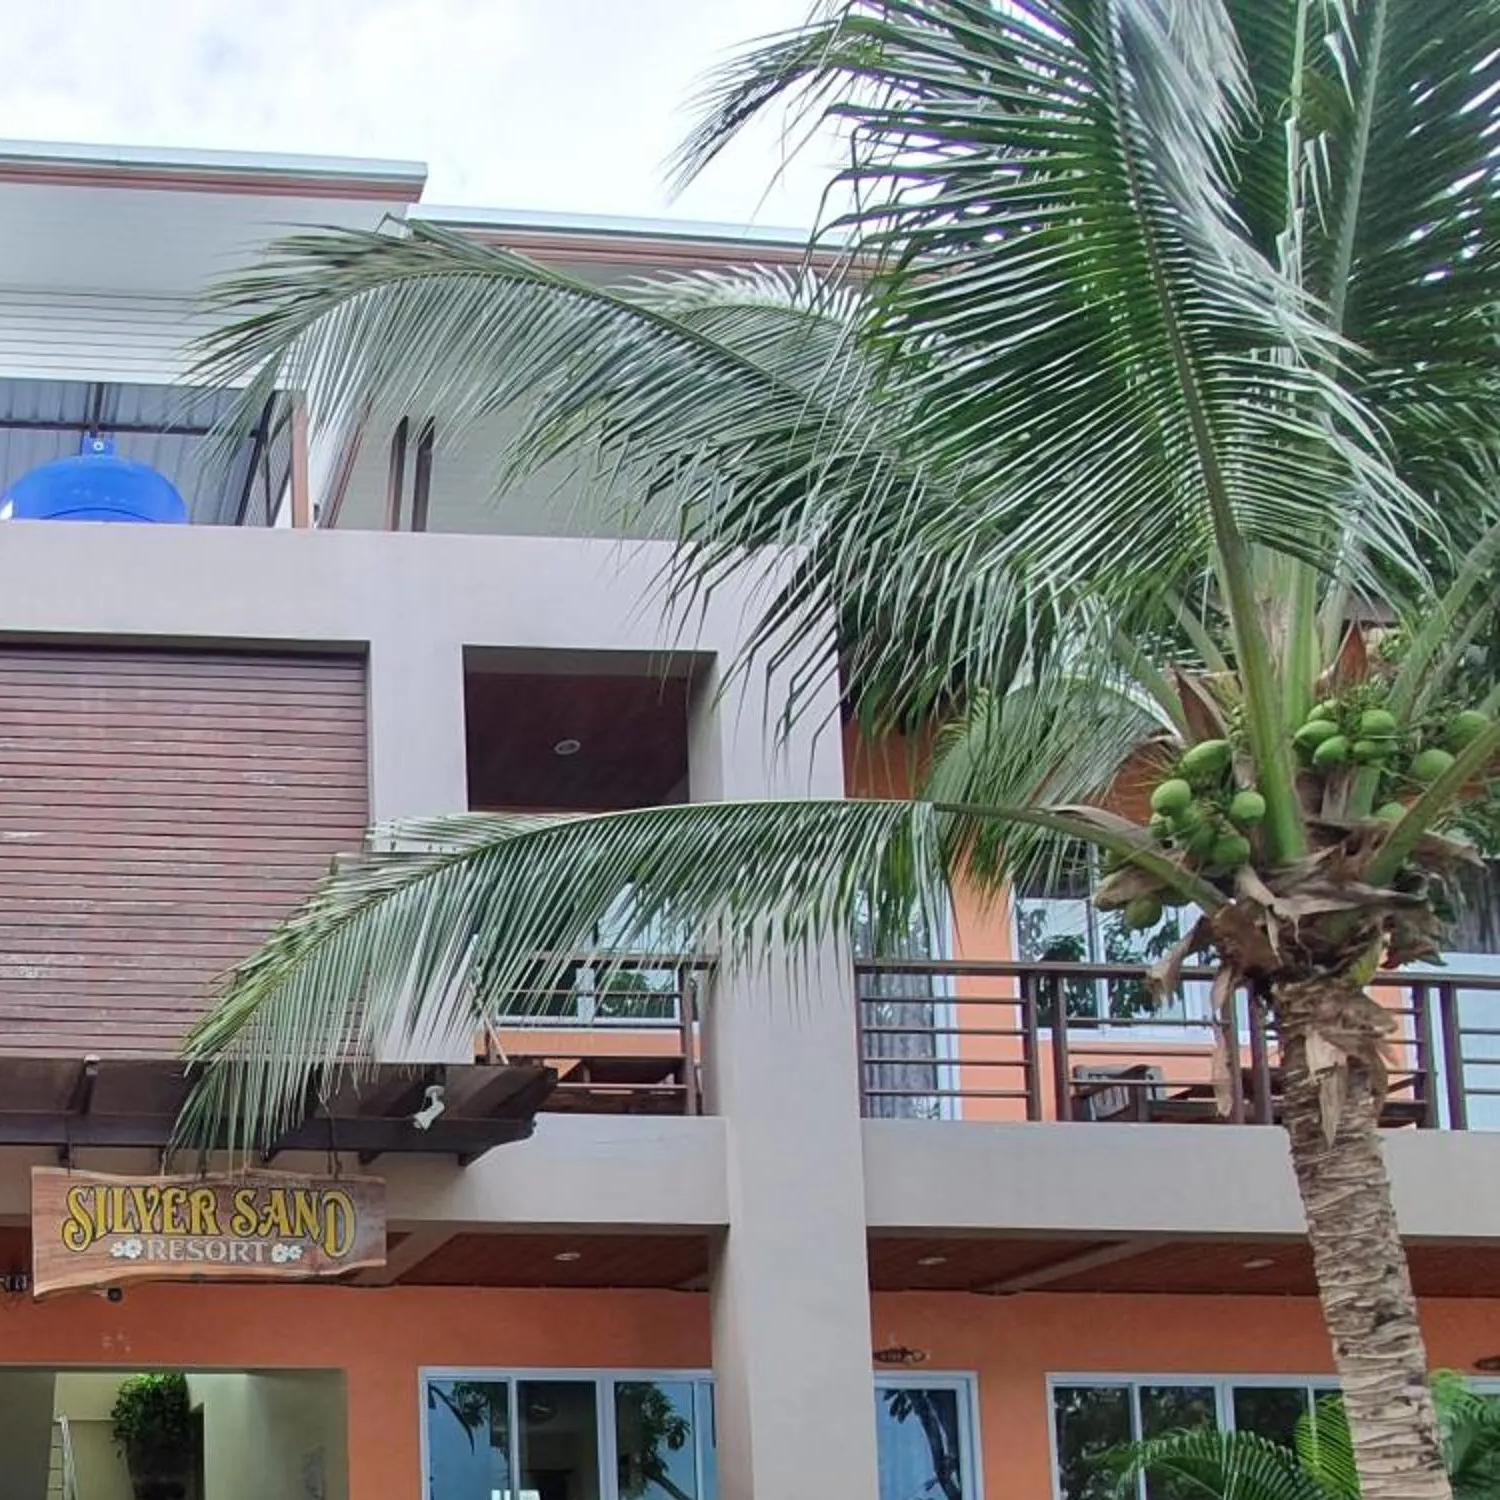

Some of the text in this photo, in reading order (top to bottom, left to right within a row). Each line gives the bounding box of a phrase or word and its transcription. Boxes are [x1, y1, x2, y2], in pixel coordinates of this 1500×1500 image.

[61, 1185, 357, 1258] SILVER SAND
[147, 1239, 270, 1264] RESORT
